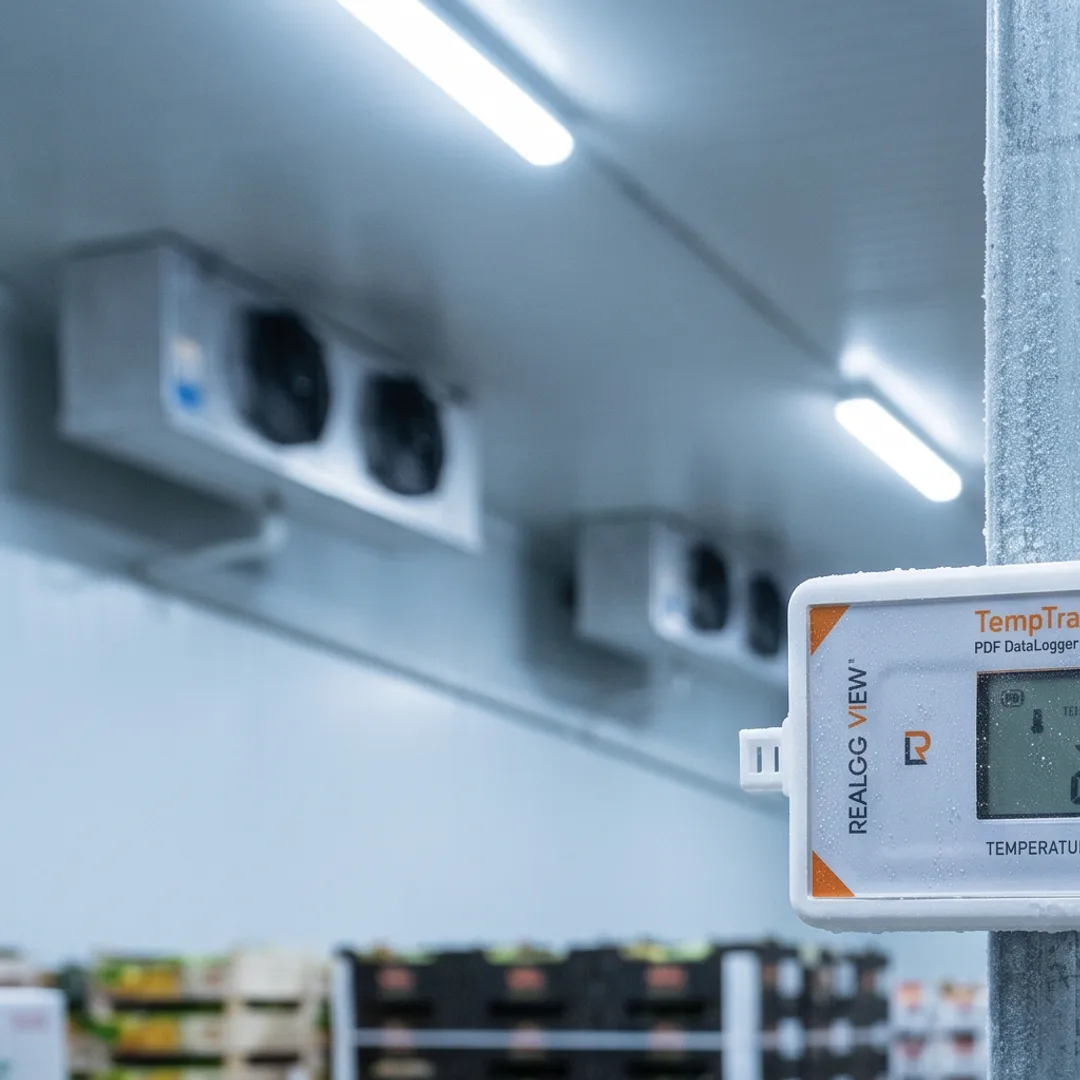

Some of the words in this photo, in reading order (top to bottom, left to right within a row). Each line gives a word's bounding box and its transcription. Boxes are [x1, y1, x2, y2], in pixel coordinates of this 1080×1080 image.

[975, 641, 1001, 655] PDF
[1005, 639, 1079, 655] DataLogger
[848, 667, 868, 728] VIEW
